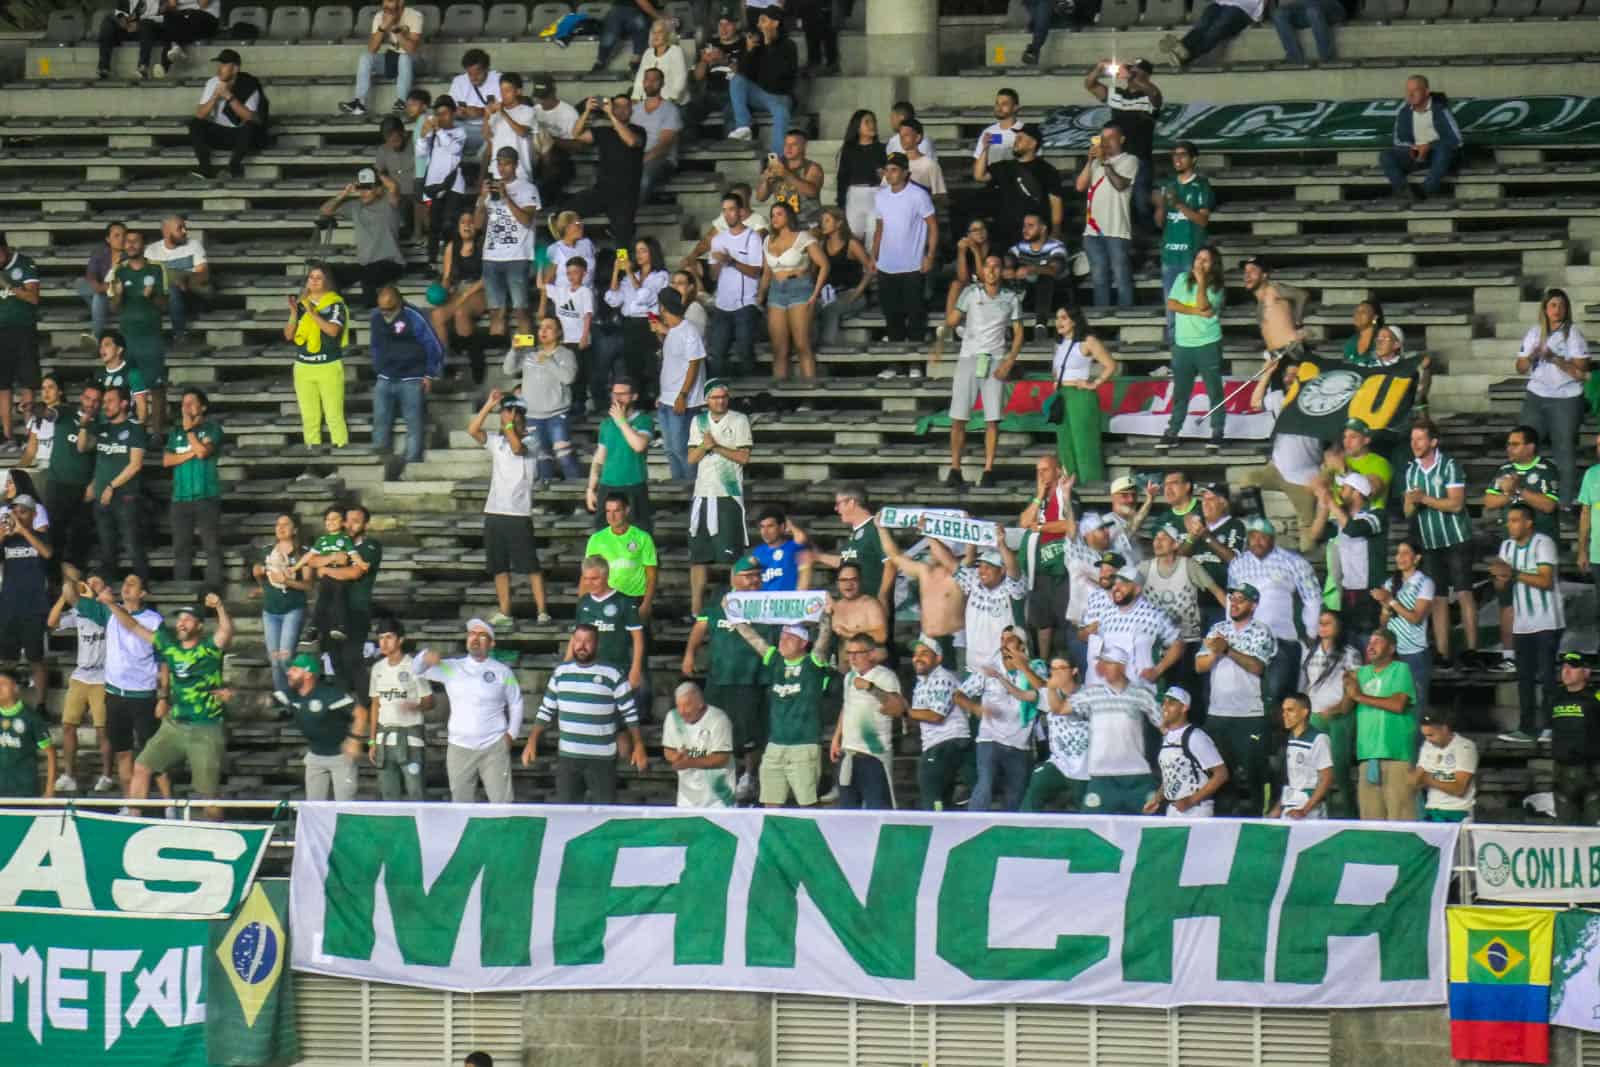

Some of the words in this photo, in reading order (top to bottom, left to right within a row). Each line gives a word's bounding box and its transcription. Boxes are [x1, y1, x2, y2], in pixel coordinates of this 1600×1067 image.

[321, 812, 1440, 984] MANCHA
[1511, 847, 1555, 889] CON
[1559, 847, 1585, 889] LA
[0, 942, 207, 1052] METAL
